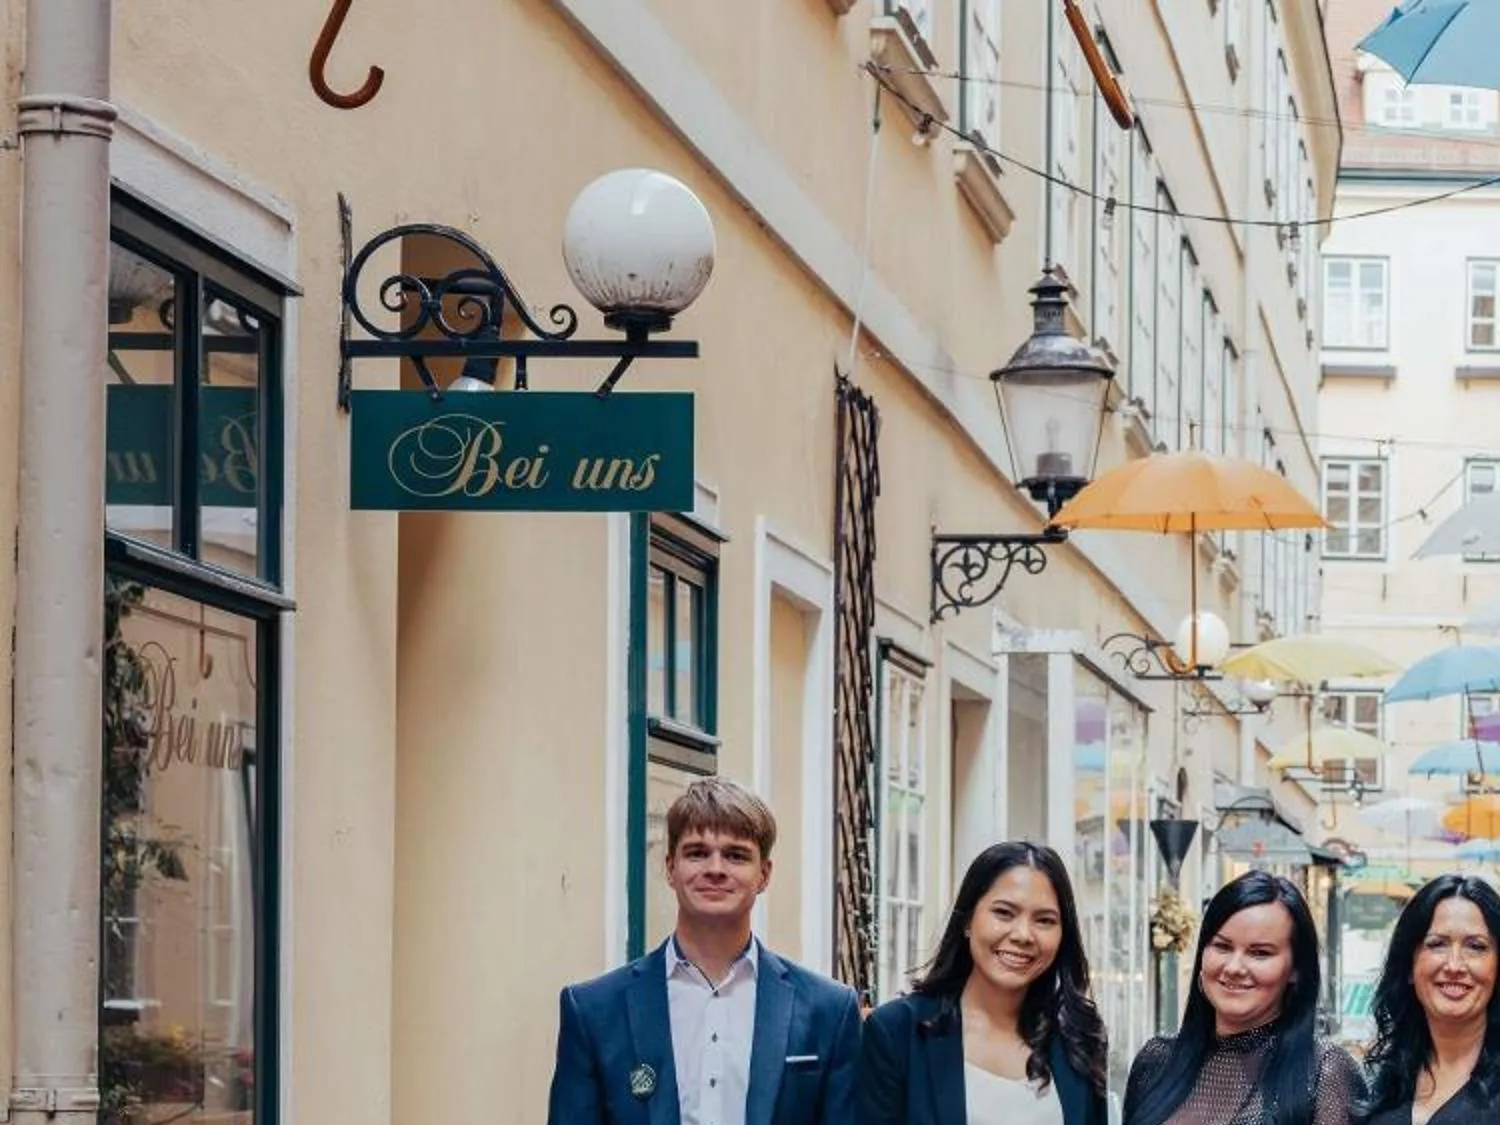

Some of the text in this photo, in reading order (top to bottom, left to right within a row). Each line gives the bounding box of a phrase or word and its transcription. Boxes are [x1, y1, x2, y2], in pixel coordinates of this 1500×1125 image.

[388, 413, 661, 497] Bei uns
[132, 641, 197, 772] Bei
